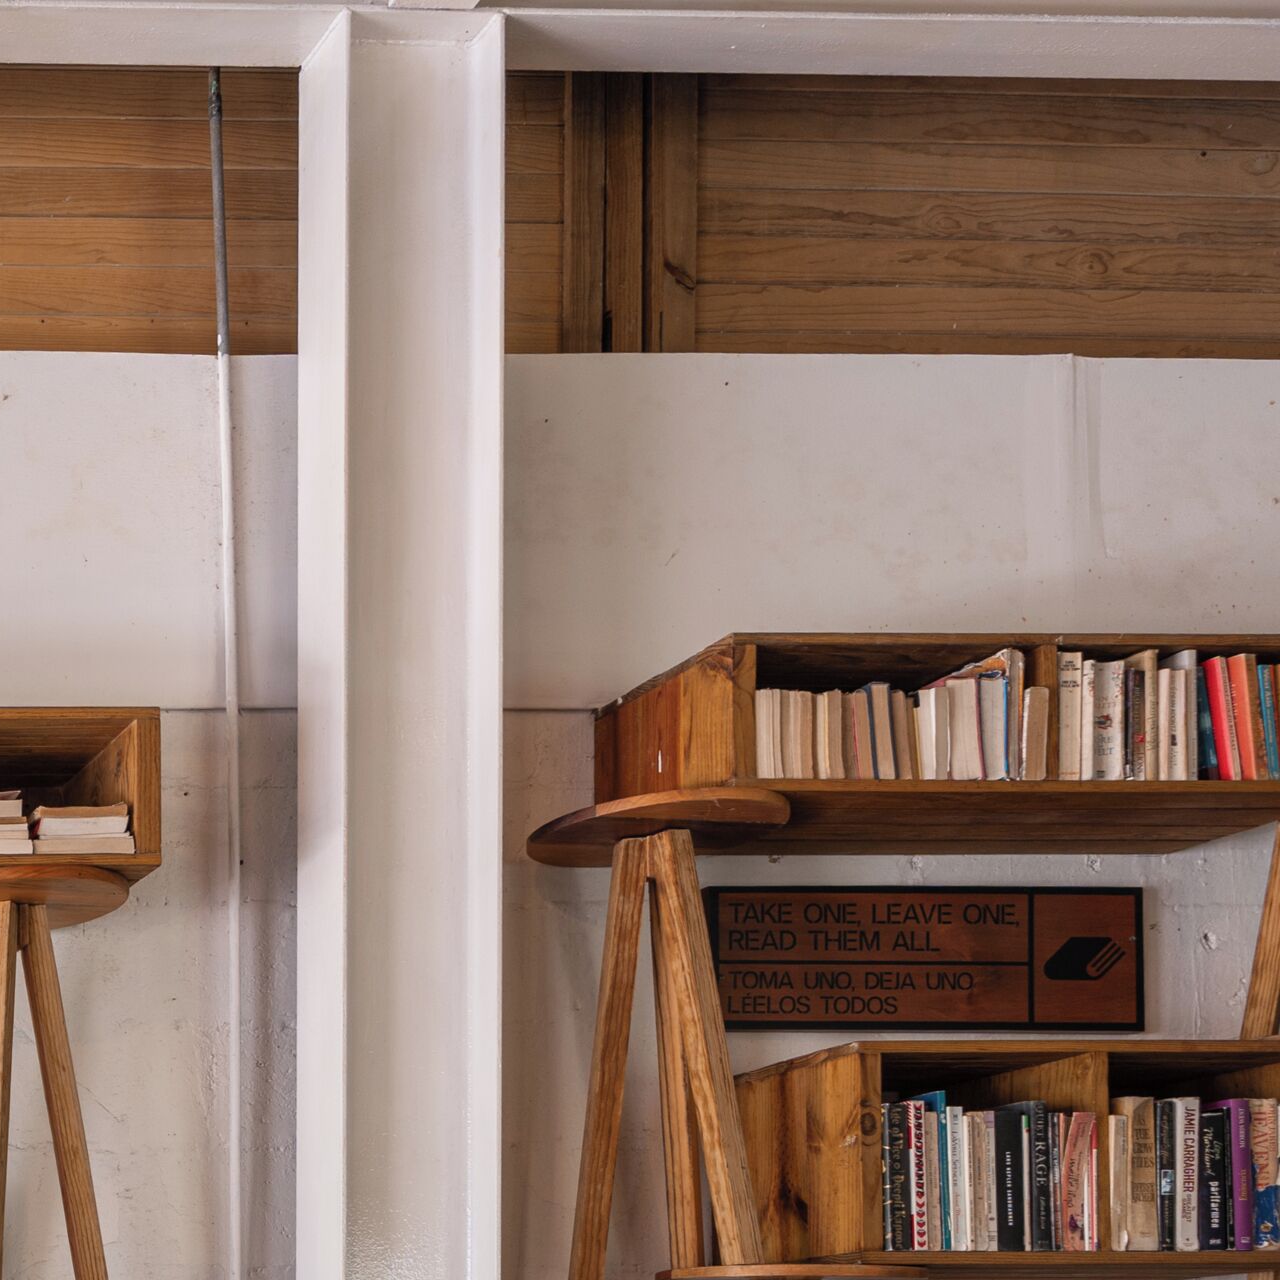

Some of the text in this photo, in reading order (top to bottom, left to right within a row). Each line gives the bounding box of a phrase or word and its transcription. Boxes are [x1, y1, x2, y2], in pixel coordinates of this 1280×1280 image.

[728, 902, 1021, 928] TAKE ONE, LEAVE ONE,
[728, 930, 941, 953] READ THEM ALL
[728, 971, 794, 990] TOMA
[803, 971, 855, 992] UNO,
[864, 972, 916, 990] DEJA
[726, 992, 898, 1014] LÉELOS TODOS
[892, 1127, 904, 1137] of
[1183, 1106, 1196, 1193] JAMIE CARRAGHER
[1035, 1141, 1047, 1187] RAGE
[892, 1174, 905, 1208] Deepti
[895, 1211, 906, 1249] Kapoor
